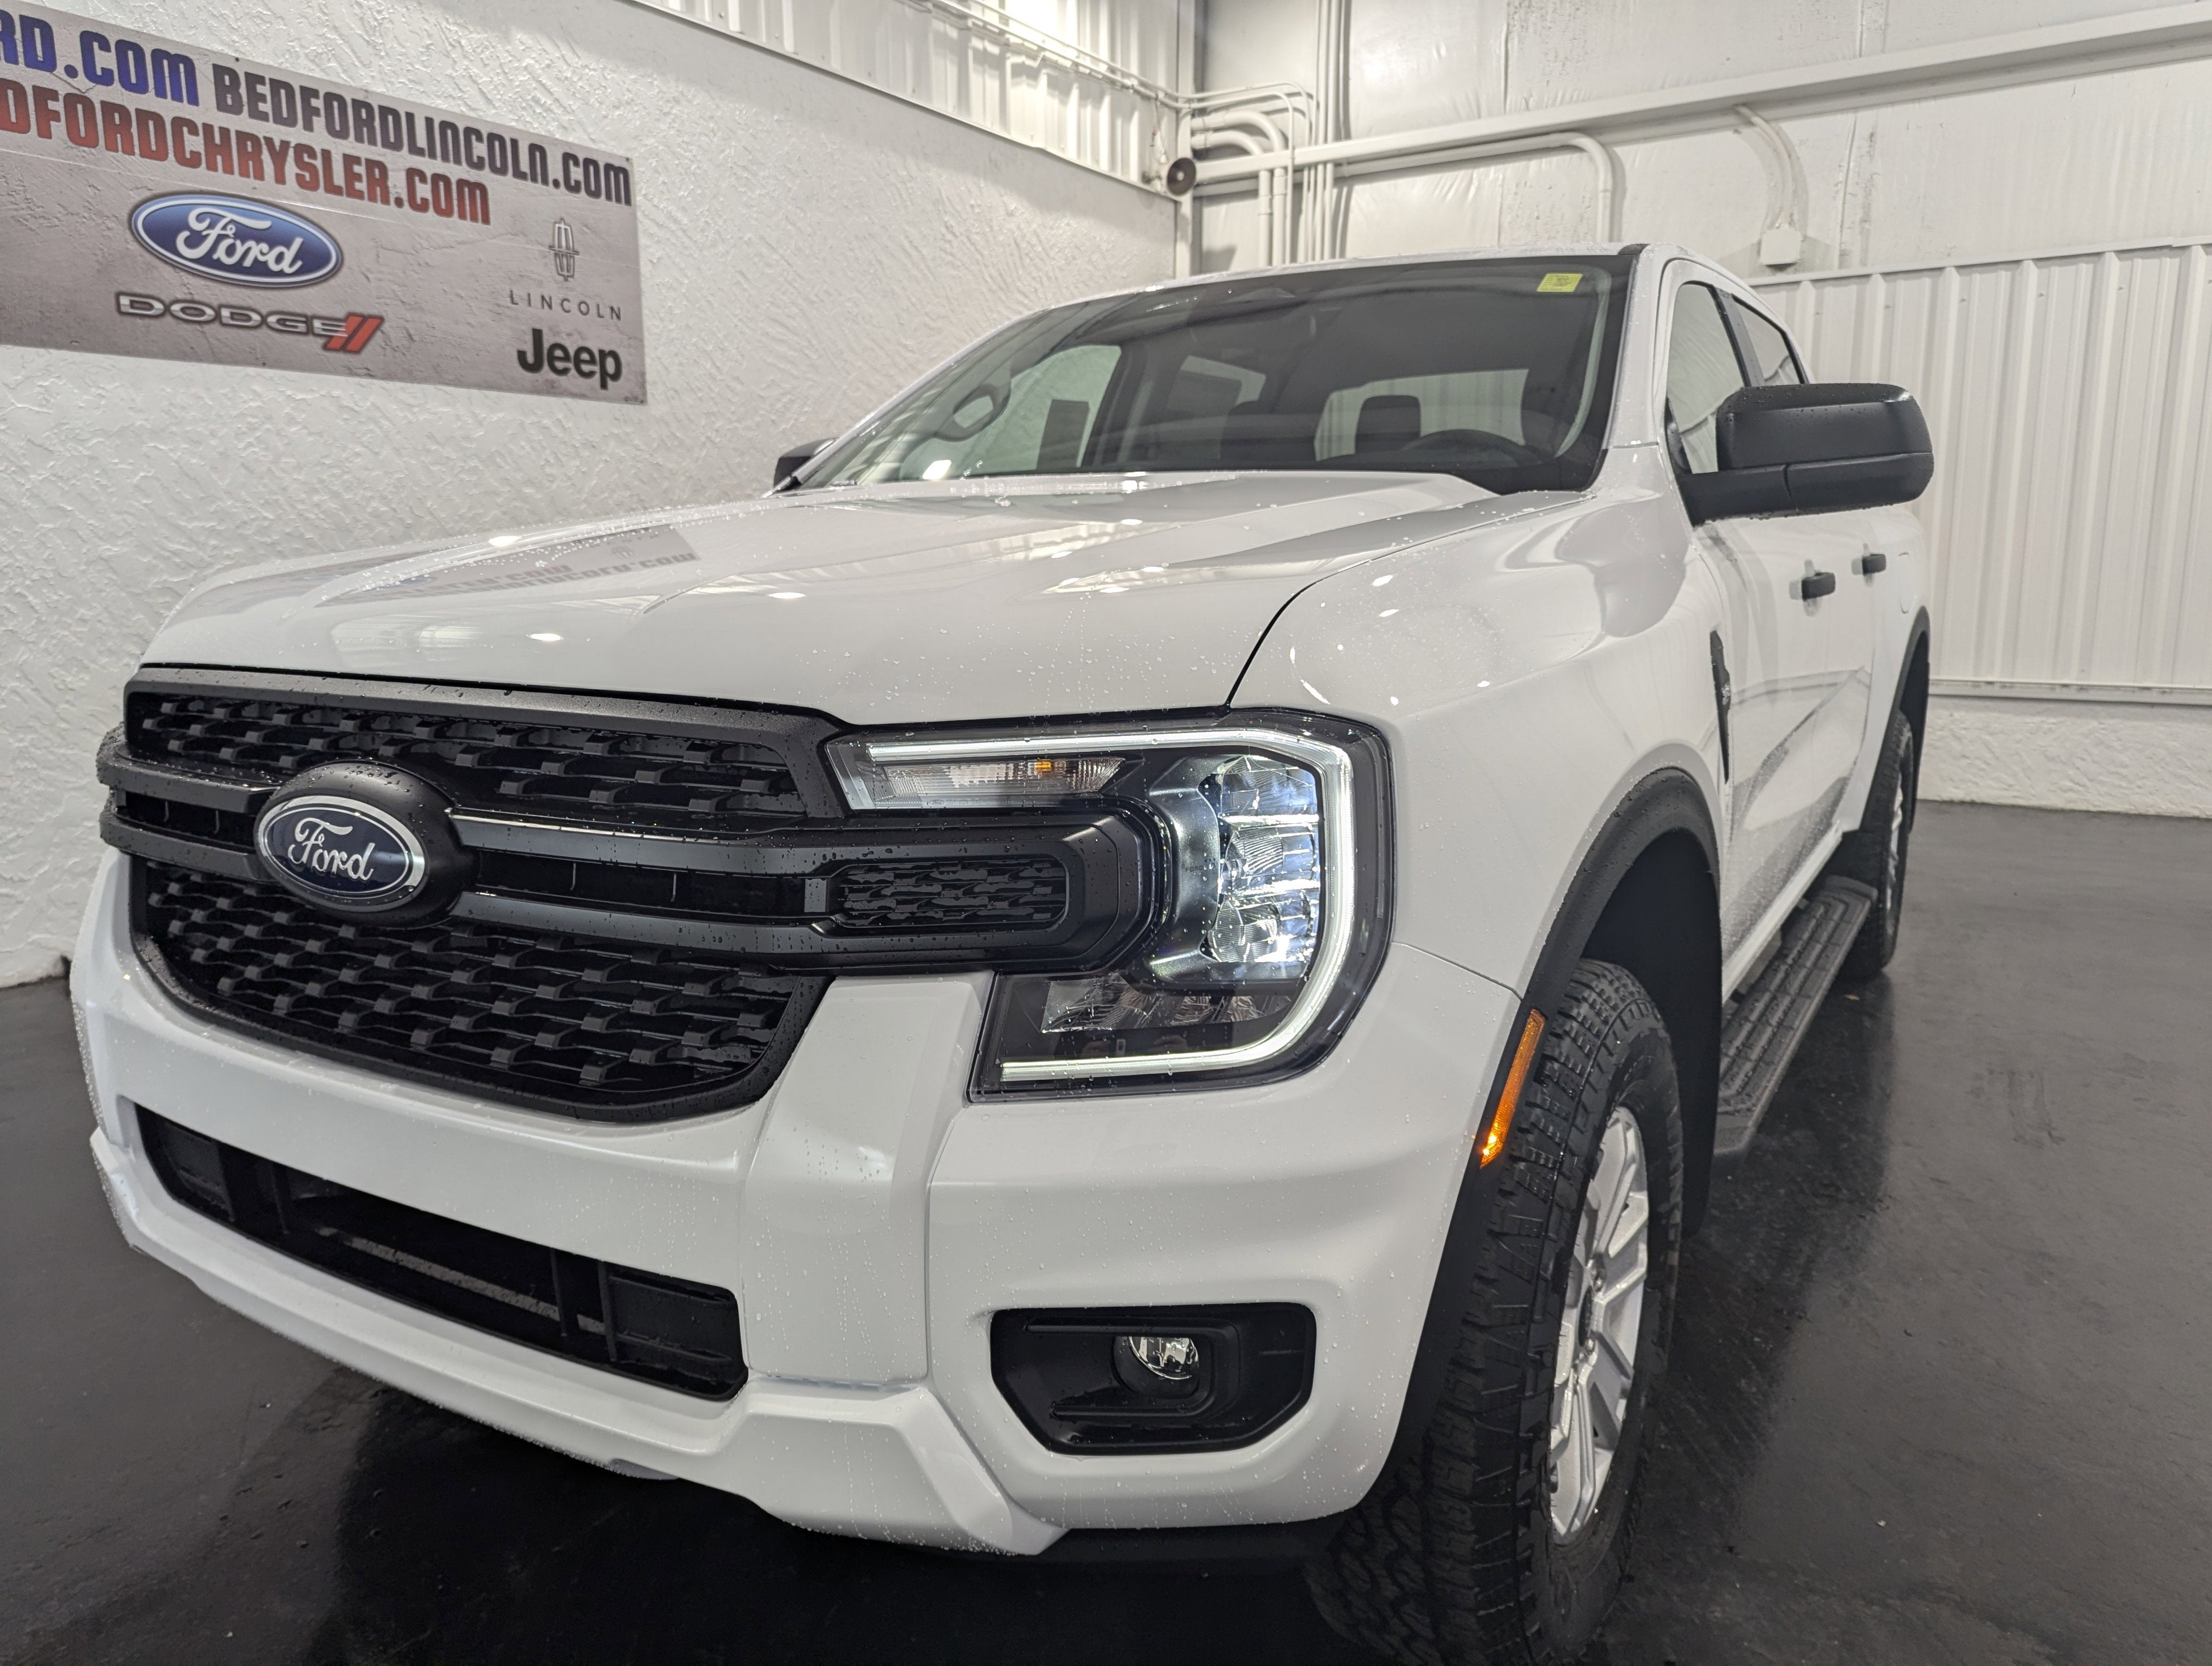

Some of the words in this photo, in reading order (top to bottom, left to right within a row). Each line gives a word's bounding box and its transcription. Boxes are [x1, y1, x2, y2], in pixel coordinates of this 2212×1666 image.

[0, 77, 491, 226] DFORDCHRYSLER.COM
[212, 63, 632, 207] BEDFORDLINCOLN.COM
[175, 207, 304, 274] Ford
[116, 293, 349, 337] DODGE
[509, 289, 621, 321] LINCOLN
[516, 328, 623, 391] Jeep
[287, 817, 376, 881] Ford
